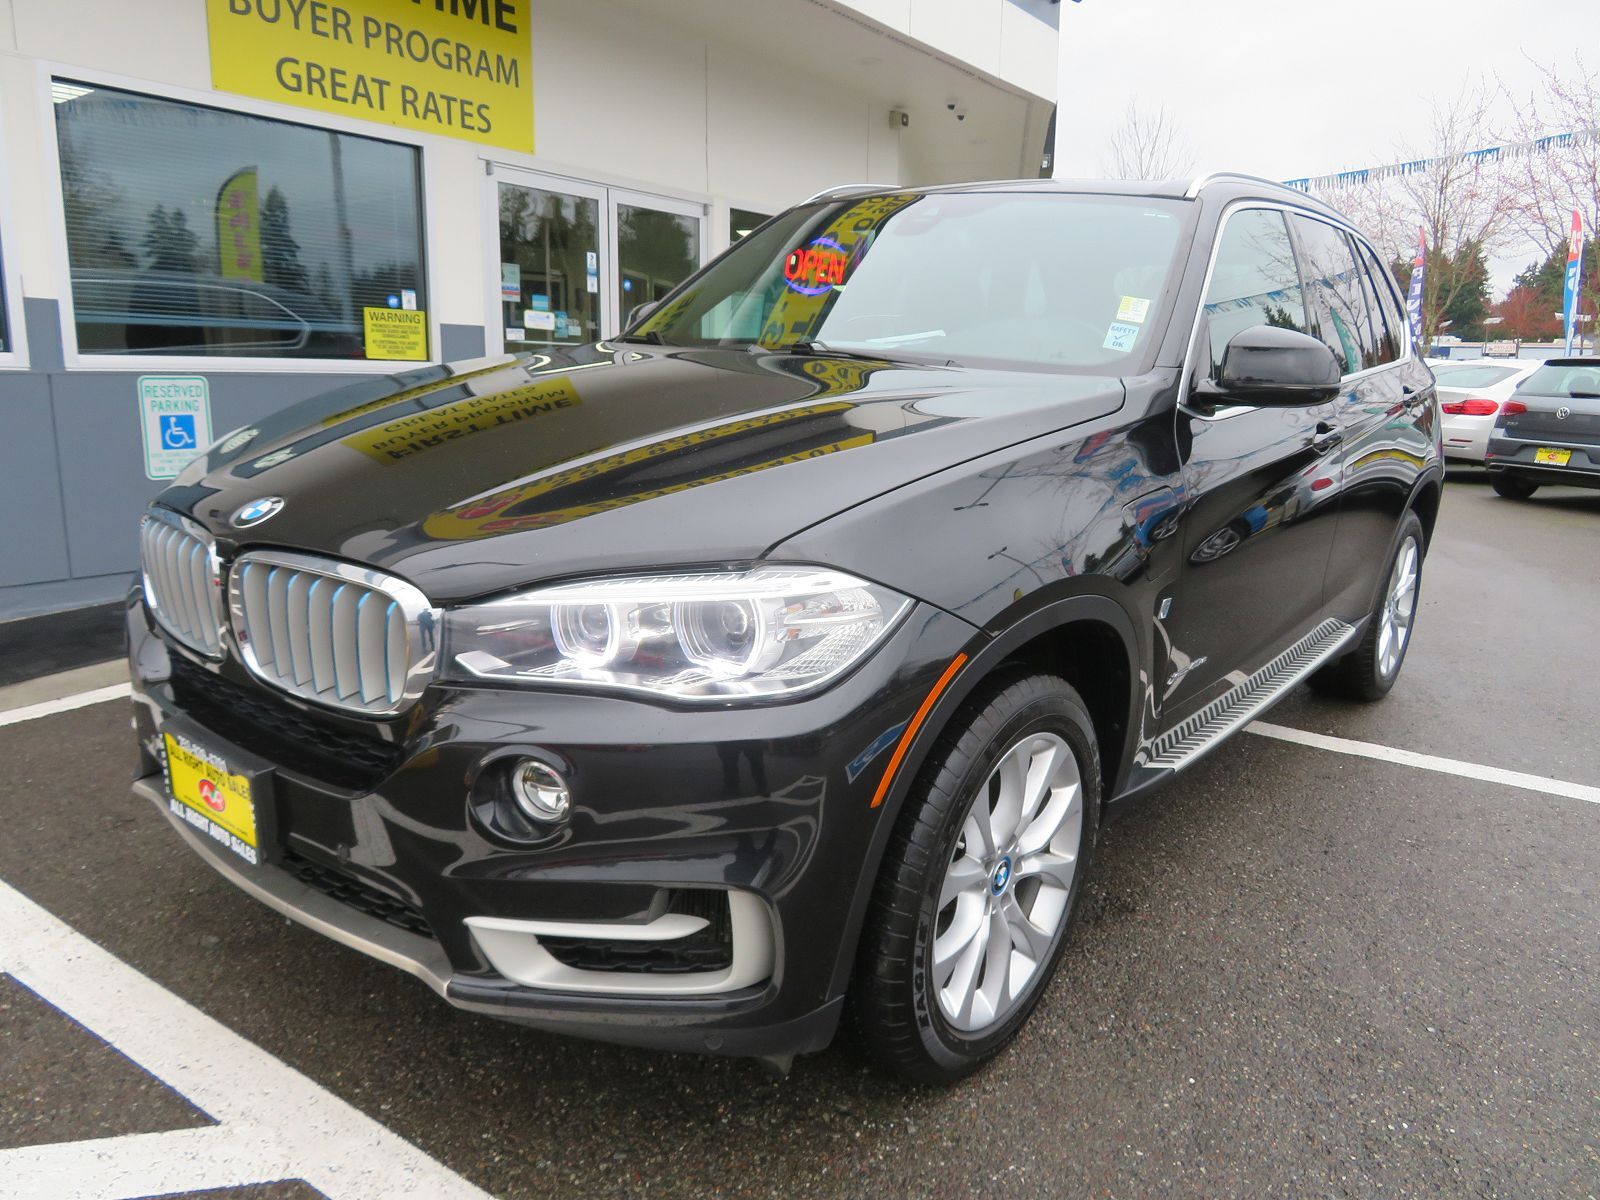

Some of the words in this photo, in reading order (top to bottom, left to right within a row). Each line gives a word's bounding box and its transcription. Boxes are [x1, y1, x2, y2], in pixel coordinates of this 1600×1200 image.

[412, 0, 517, 34] ME
[362, 16, 519, 87] PROGRAM
[275, 57, 391, 111] GREAT
[401, 85, 492, 133] RATES
[784, 248, 846, 284] OPEN
[369, 312, 421, 325] WARNING
[1111, 325, 1137, 335] SAFETY
[1112, 341, 1124, 349] OK
[144, 385, 202, 398] RESERVED
[151, 400, 200, 412] PARKING
[170, 798, 186, 818] ALL
[209, 821, 231, 846] AUTO
[230, 836, 258, 865] SALES
